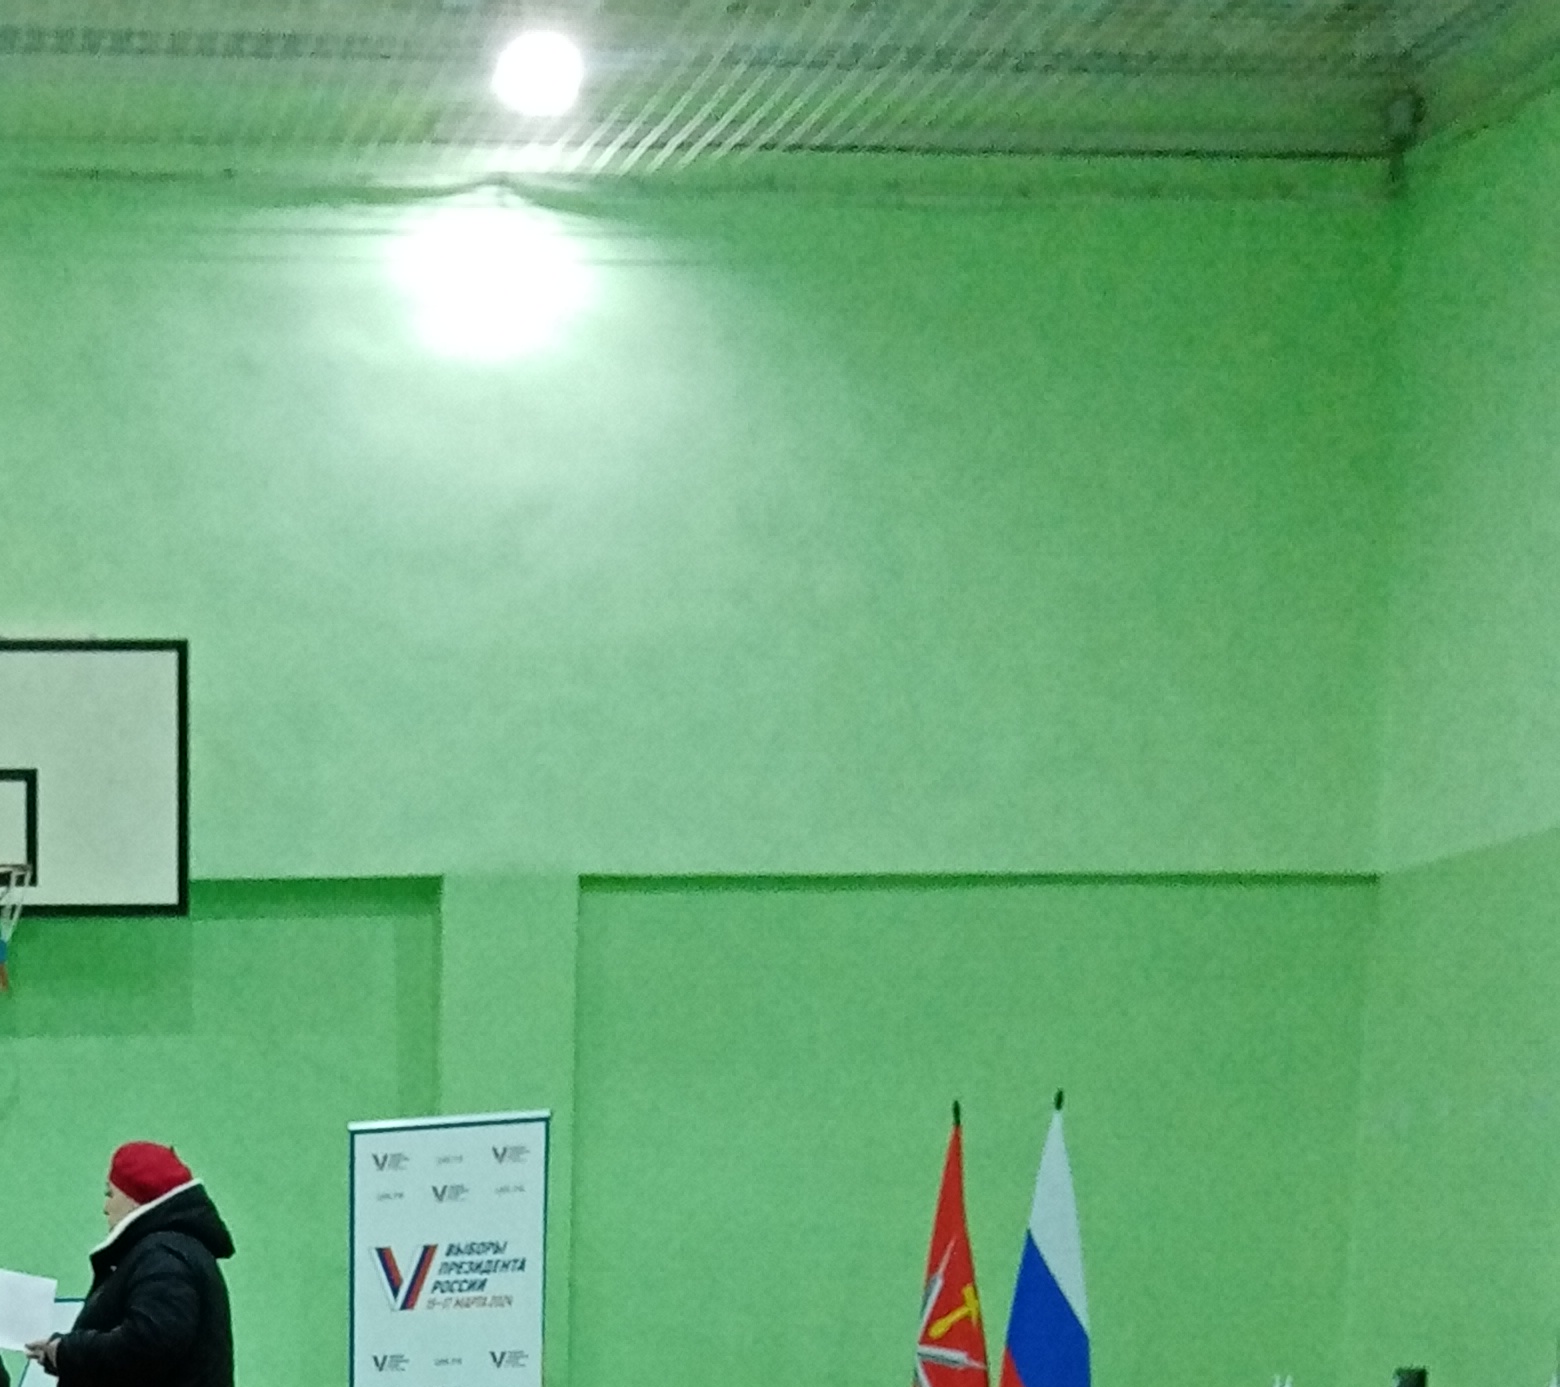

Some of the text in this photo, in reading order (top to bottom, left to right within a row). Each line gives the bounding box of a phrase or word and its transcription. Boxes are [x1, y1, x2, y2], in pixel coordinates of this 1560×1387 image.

[445, 1241, 508, 1257] ВЫБОРЫ
[439, 1257, 527, 1275] ПРЕЗИДЕНТА
[431, 1277, 488, 1294] РОССИИ
